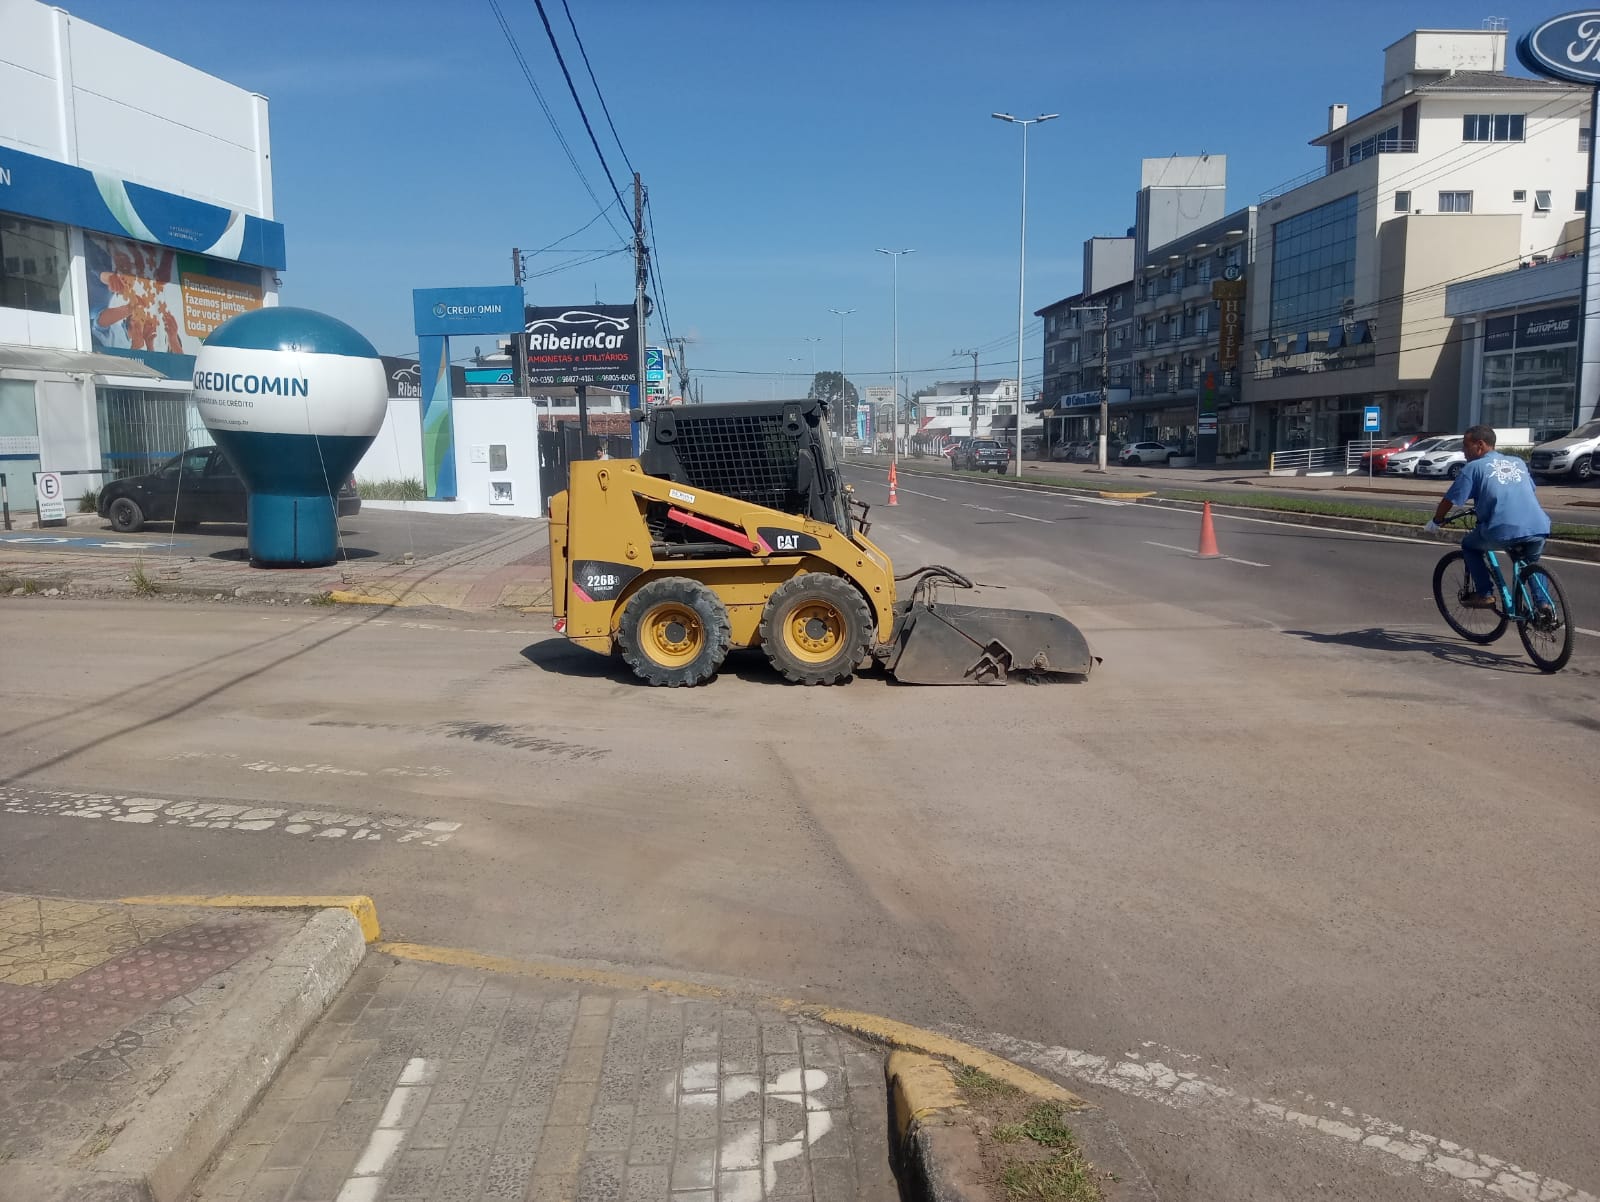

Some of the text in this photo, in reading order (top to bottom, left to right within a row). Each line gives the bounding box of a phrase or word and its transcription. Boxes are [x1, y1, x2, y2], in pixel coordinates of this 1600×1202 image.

[184, 278, 226, 296] Pensamos
[185, 292, 220, 309] fazemos
[186, 306, 202, 317] Por
[202, 310, 221, 321] você
[447, 304, 502, 315] CREDICOMIN
[187, 320, 207, 332] toda
[1225, 300, 1238, 358] HOTEL
[528, 354, 573, 363] AMIONETAS
[582, 352, 629, 363] UTILITÁRIOS
[194, 371, 309, 397] CREDICOMIN
[397, 381, 422, 397] Ribei
[45, 479, 54, 494] E
[777, 535, 800, 550] CAT
